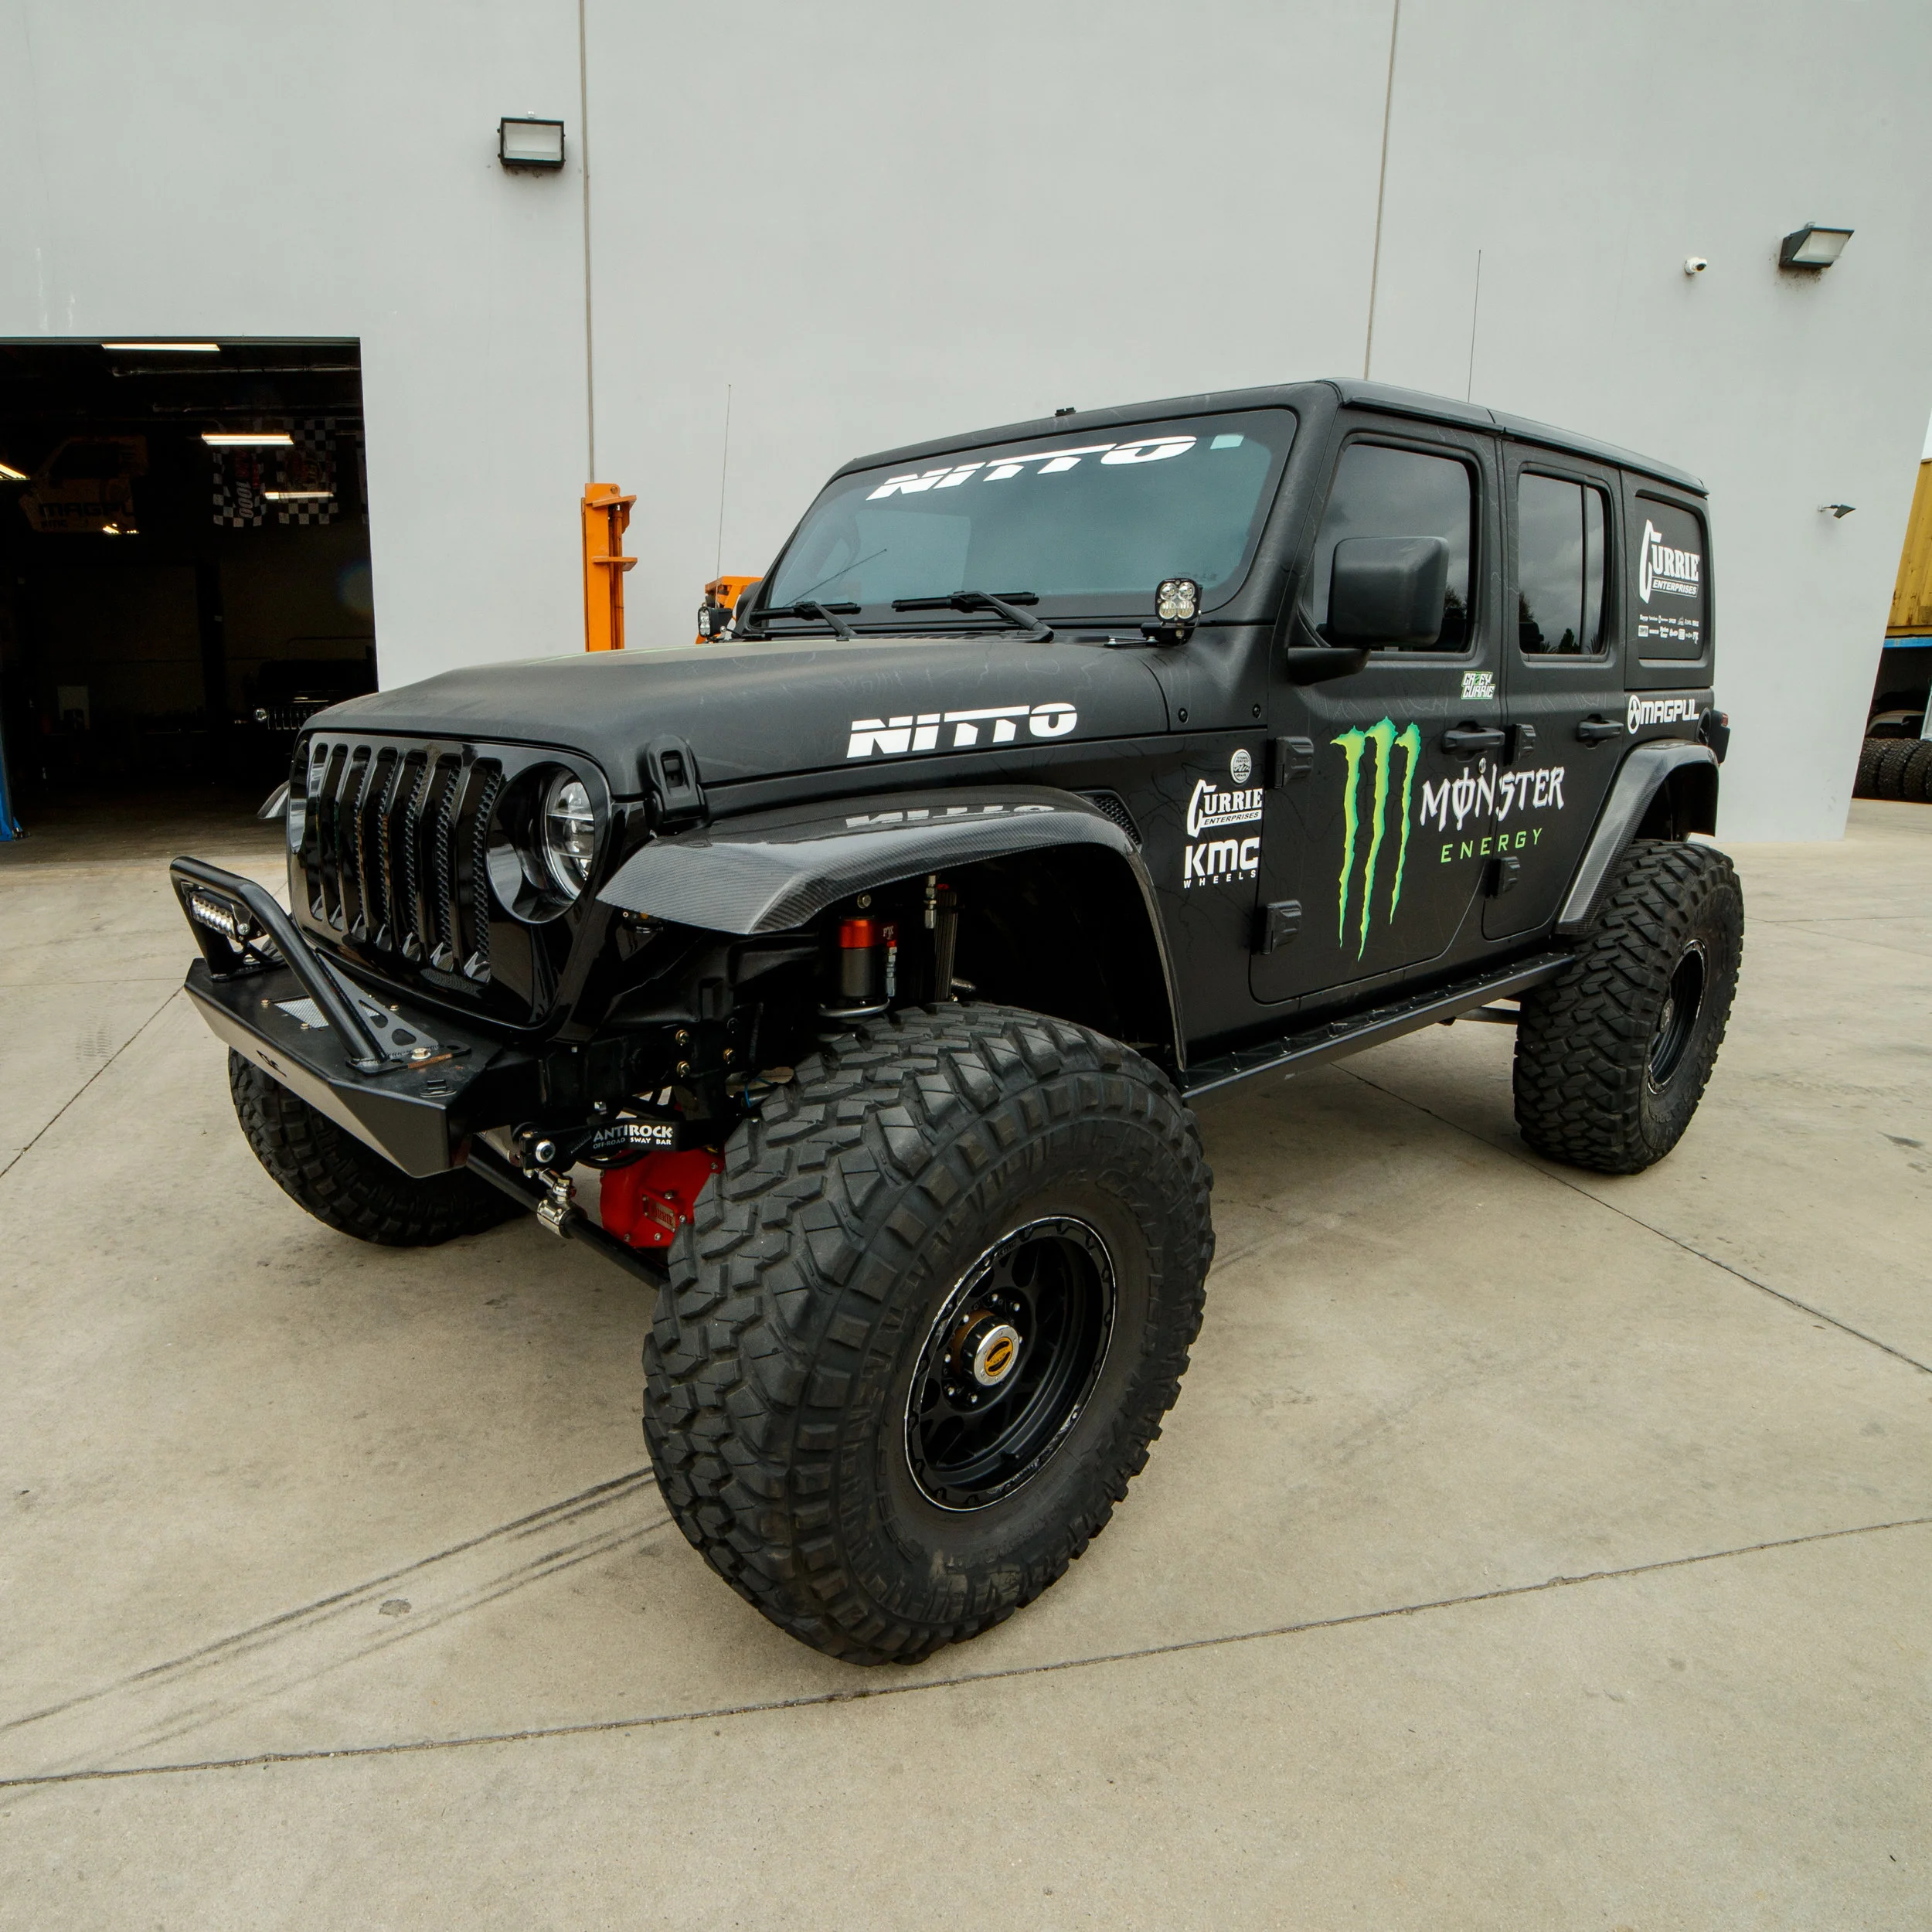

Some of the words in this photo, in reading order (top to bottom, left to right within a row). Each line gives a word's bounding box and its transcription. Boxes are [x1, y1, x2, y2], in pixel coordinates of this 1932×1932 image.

[866, 435, 1197, 501] NITTO
[1639, 519, 1700, 604] CURRIE
[1652, 579, 1698, 596] ENTERPRISES
[1640, 698, 1699, 725] MAGPUL
[846, 703, 1078, 759] NITTO
[1186, 779, 1264, 838] CURRIE
[1420, 763, 1565, 832] MONSTER
[1202, 811, 1260, 826] ENTERPRISES
[1184, 837, 1260, 879] KMC
[1440, 828, 1543, 864] ENERGY
[1183, 869, 1258, 889] WHEELS
[593, 1124, 674, 1143] ANTIROCK
[593, 1137, 626, 1150] OFF-ROAD
